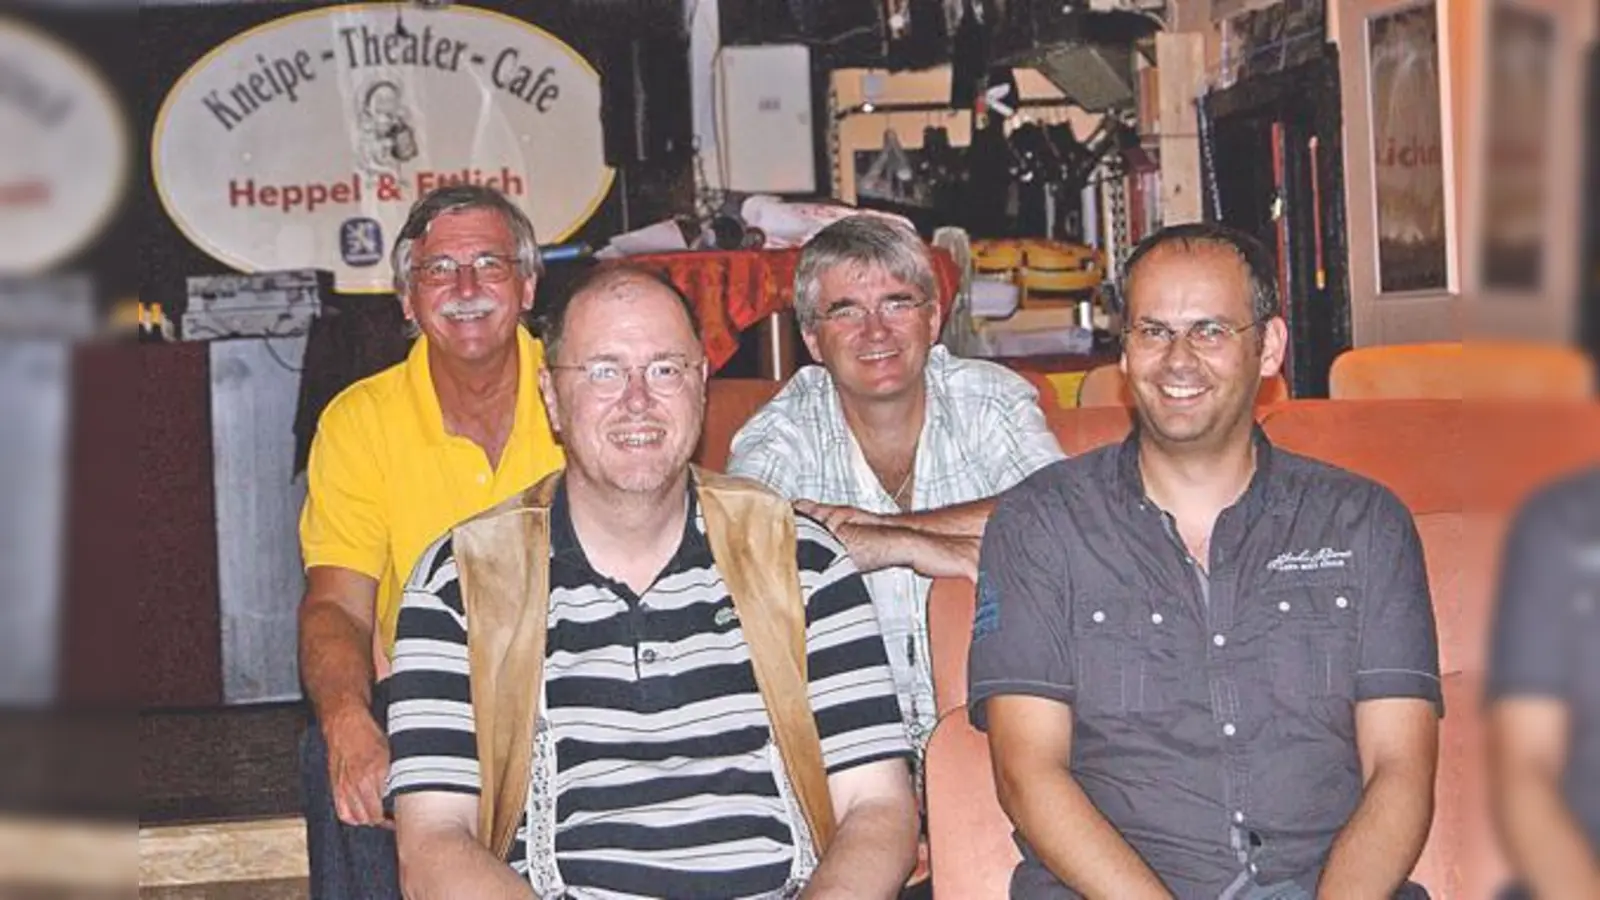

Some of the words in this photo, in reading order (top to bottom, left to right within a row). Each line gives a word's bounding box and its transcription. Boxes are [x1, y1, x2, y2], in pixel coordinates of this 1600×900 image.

[202, 49, 316, 132] Kneipe
[339, 25, 467, 72] Theater
[491, 47, 560, 114] Cafe
[229, 172, 361, 213] Heppel
[377, 172, 401, 201] &
